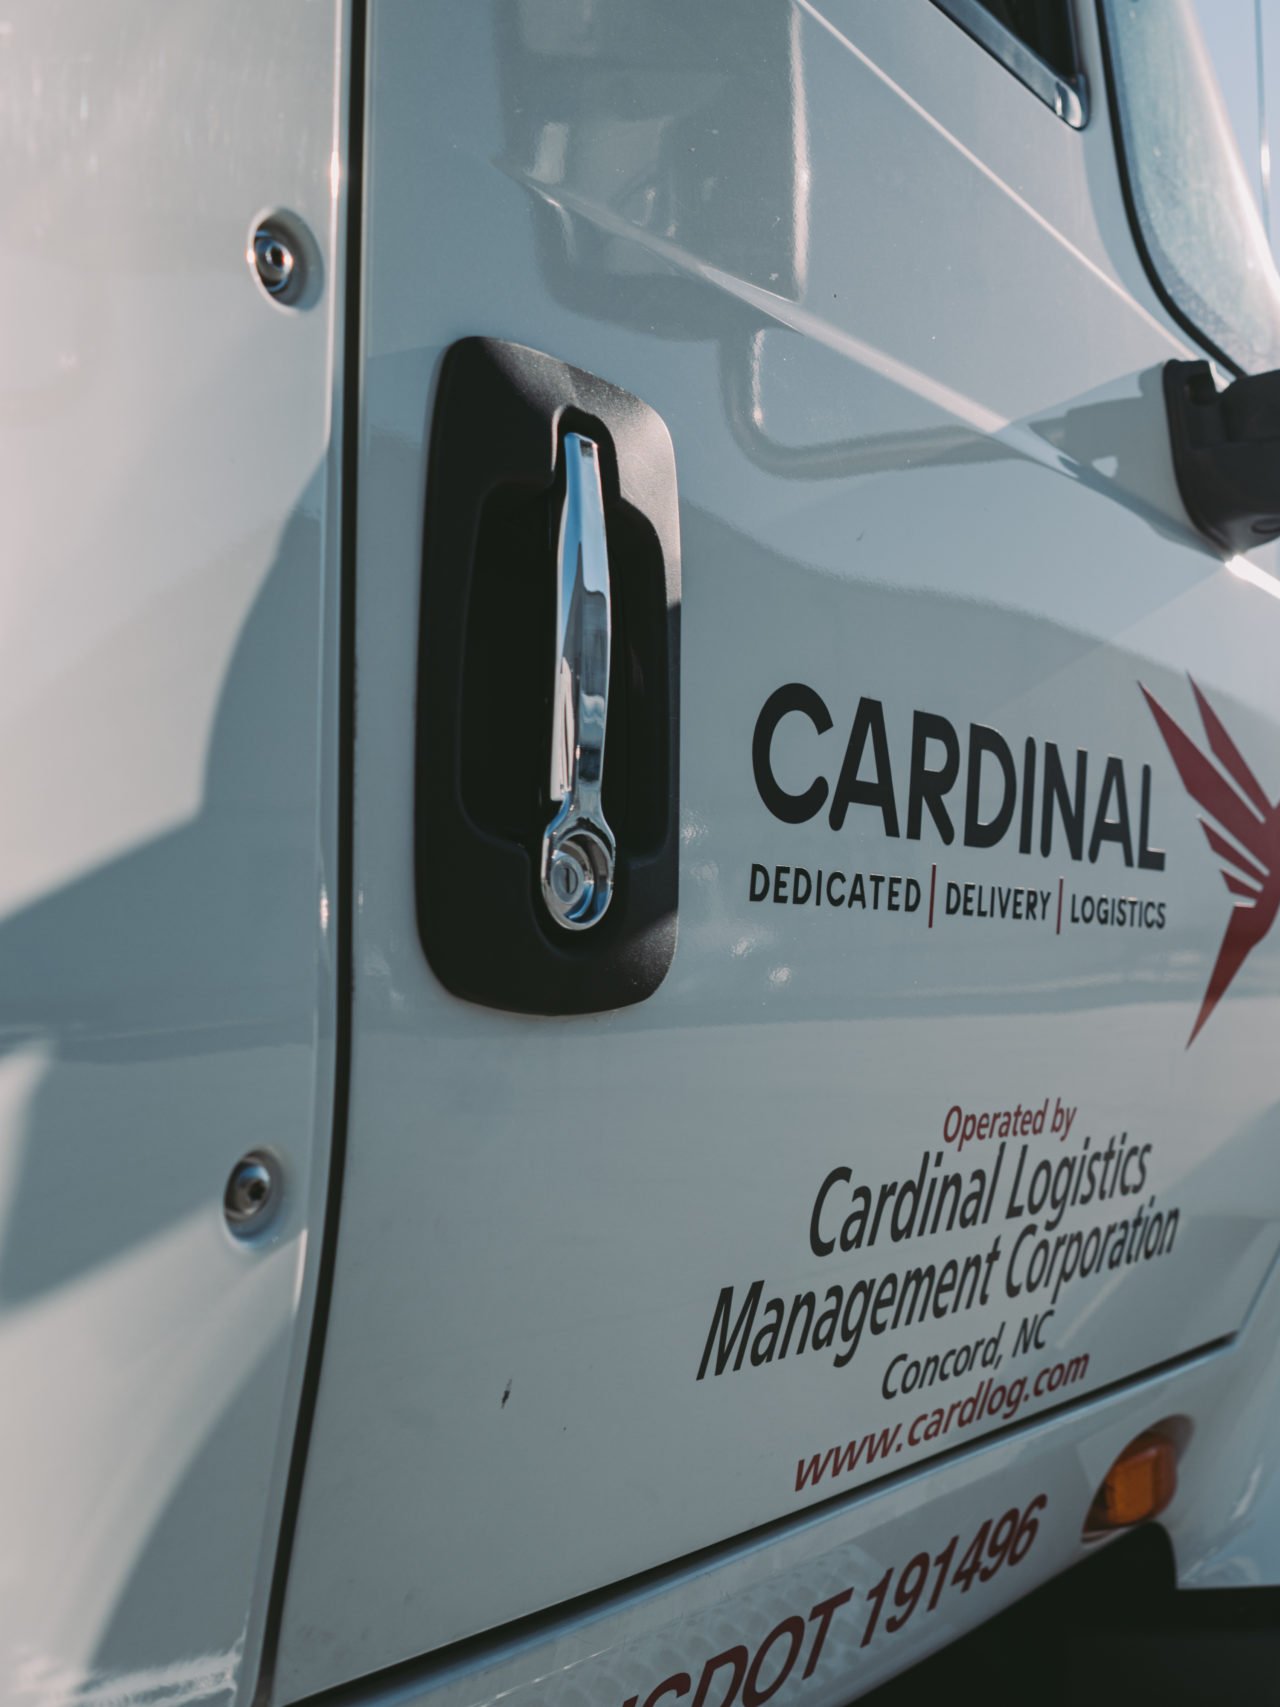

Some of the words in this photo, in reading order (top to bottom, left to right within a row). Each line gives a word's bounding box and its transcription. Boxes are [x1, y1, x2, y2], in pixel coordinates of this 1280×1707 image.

[752, 682, 1166, 872] CARDINAL
[748, 863, 921, 913] DEDICATED
[945, 880, 1052, 921] DELIVERY
[1070, 894, 1167, 930] LOGISTICS
[942, 1098, 1050, 1152] Operated
[1051, 1098, 1077, 1142] by
[809, 1141, 1006, 1257] Cardinal
[1006, 1132, 1152, 1231] Logistics
[696, 1235, 1002, 1381] Management
[1006, 1195, 1180, 1304] Corporation
[882, 1321, 1006, 1400] Concord,
[1012, 1310, 1057, 1360] NC
[794, 1352, 1090, 1492] www.cardlog.com
[622, 1586, 855, 1707] DOT
[860, 1494, 1048, 1649] 191496
